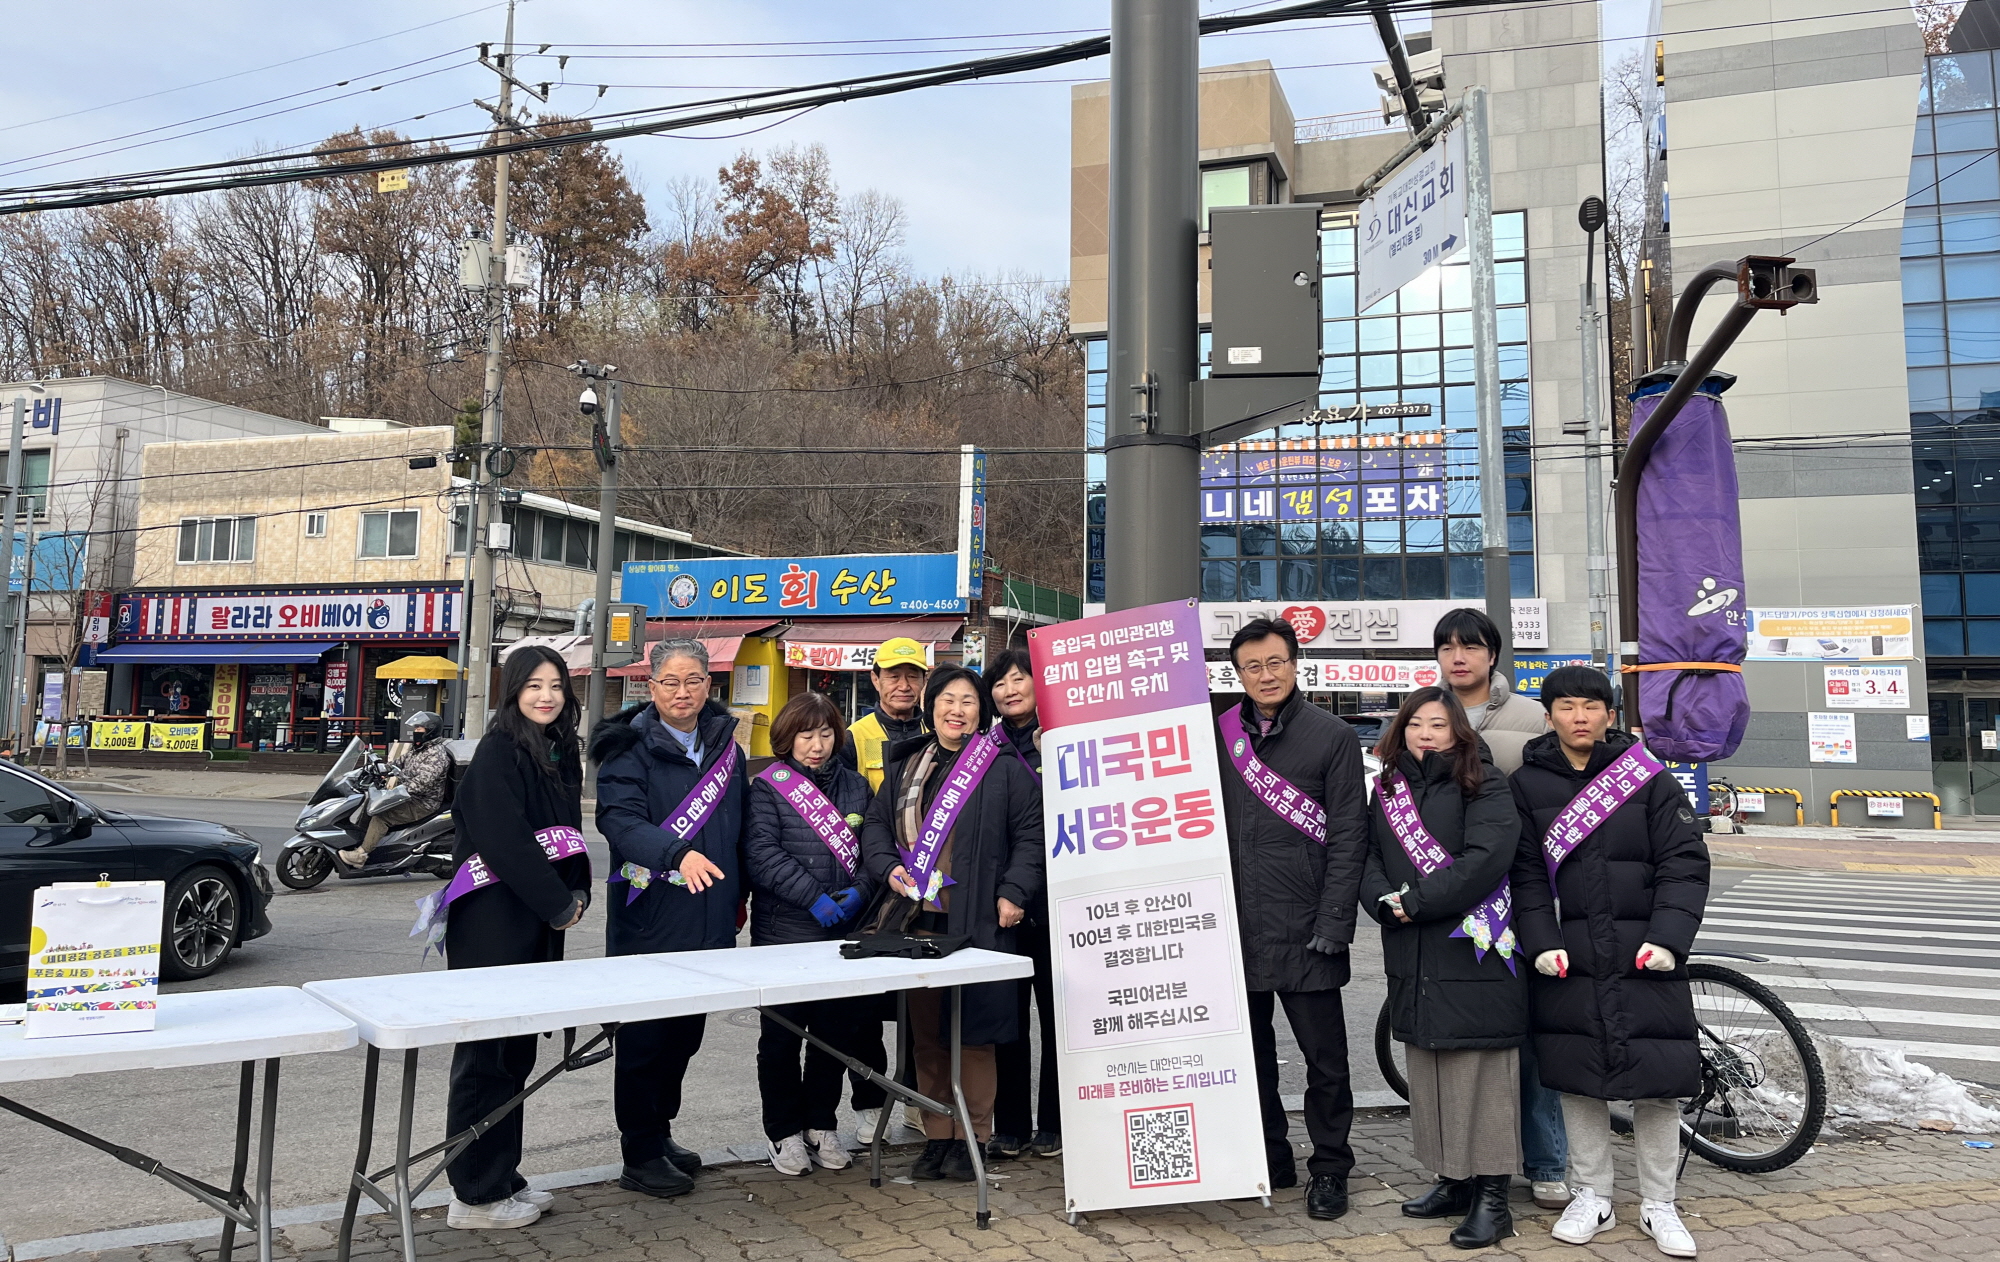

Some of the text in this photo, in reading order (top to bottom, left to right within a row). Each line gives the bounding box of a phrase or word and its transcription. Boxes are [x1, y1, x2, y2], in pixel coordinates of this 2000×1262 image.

[1388, 159, 1436, 205] 기독교대한성결교회
[1388, 162, 1454, 236] 대신교회
[33, 398, 61, 435] 비
[1378, 405, 1429, 415] 407-9377
[1418, 464, 1434, 477] 2F
[711, 573, 768, 604] 이도
[779, 563, 819, 609] 회
[830, 568, 897, 606] 수산
[211, 603, 362, 630] 랄라라 오비베어
[908, 600, 960, 610] 406-4569
[1052, 620, 1175, 656] 출입국 이민관리청
[1329, 607, 1399, 642] 진심
[1043, 641, 1190, 685] 설치 입법 촉구 및
[1325, 664, 1396, 682] 5,900
[1066, 672, 1169, 708] 안산시 유치
[104, 737, 136, 747] 3,000원
[166, 739, 198, 750] 3,000원
[169, 727, 198, 736] 오비맥주
[1057, 724, 1192, 791] 대국민
[1243, 766, 1328, 844] 경기도마을지도
[1544, 755, 1639, 854] 경기도마을지도자
[1551, 765, 1652, 863] 협의회연합회
[1738, 796, 1762, 804] 경차전용
[1876, 801, 1901, 809] 경차전용
[788, 788, 857, 877] 경기도마을지도
[1052, 789, 1215, 859] 서명운동
[1383, 791, 1436, 875] 기도마을지도
[1086, 892, 1192, 921] 10년 후 안산이
[1068, 912, 1217, 949] 100년 후 대한민국을
[127, 944, 157, 956] 꿈꾸는
[1104, 943, 1184, 969] 결정합니다
[34, 968, 90, 977] 푸른숲 사동
[1107, 982, 1188, 1006] 국민여러분
[1092, 1005, 1210, 1036] 함께 해주십시오
[1106, 1054, 1204, 1077] 안산시는 대한민국의
[1078, 1068, 1237, 1101] 미래를 준비하는 도시입니다
